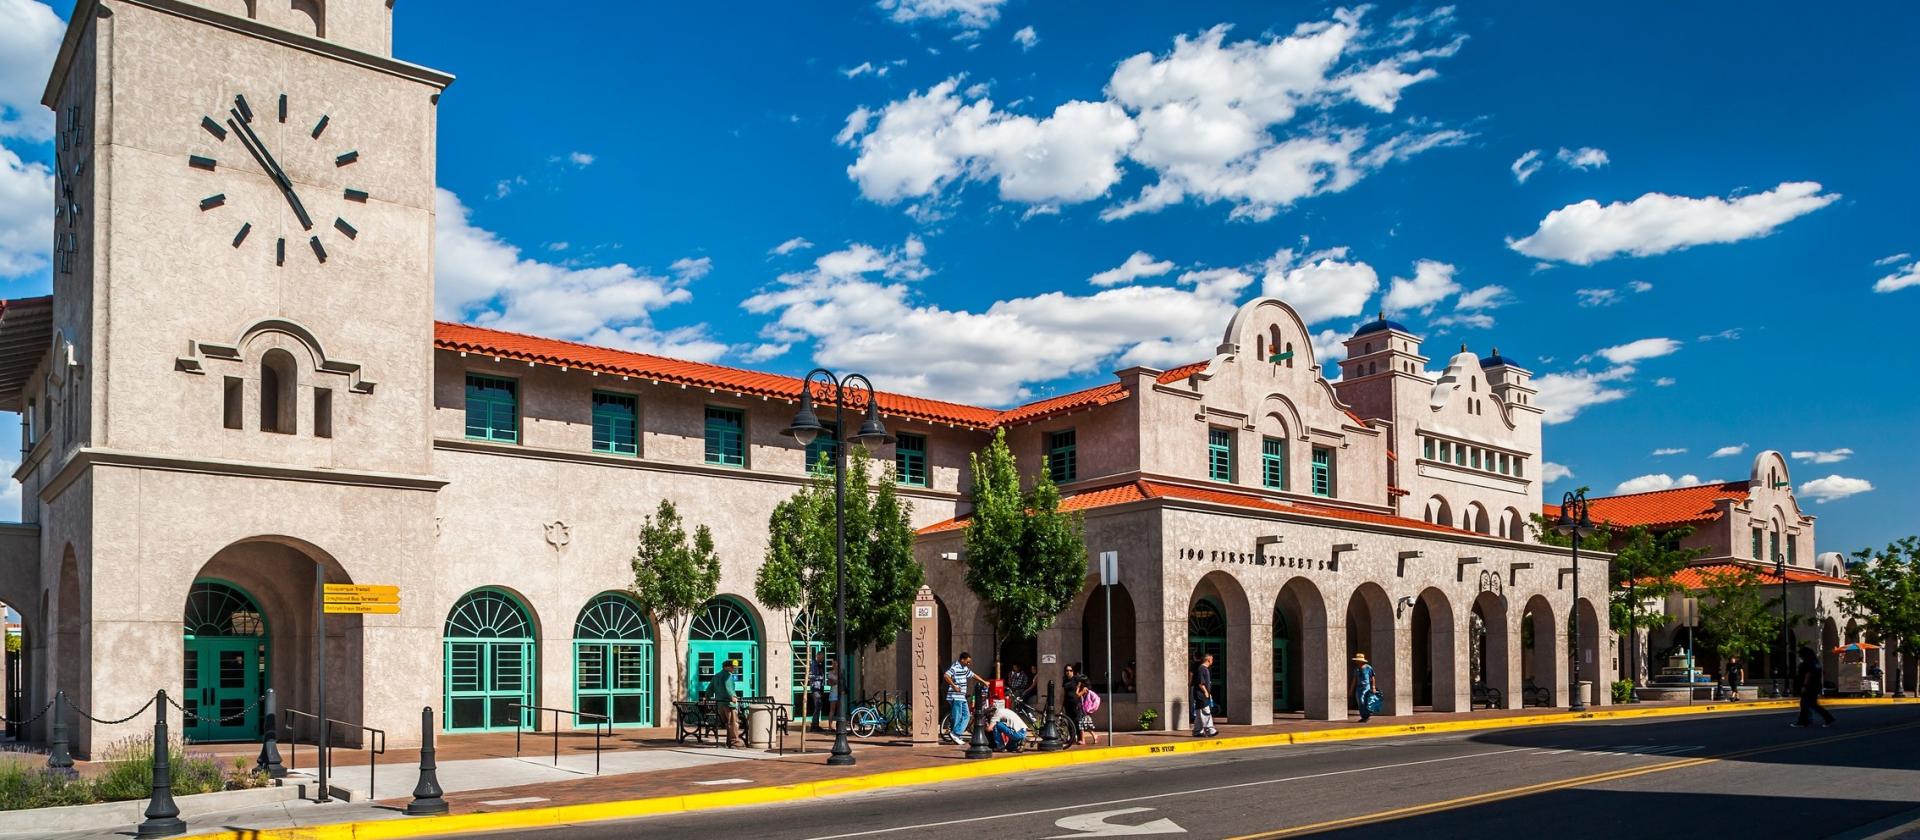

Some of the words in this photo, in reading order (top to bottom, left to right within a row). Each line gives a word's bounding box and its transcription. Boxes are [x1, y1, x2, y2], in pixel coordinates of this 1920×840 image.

[1179, 548, 1204, 561] 100
[1211, 551, 1255, 565] FIRST
[1261, 554, 1313, 569] STREET
[914, 625, 926, 669] Ride
